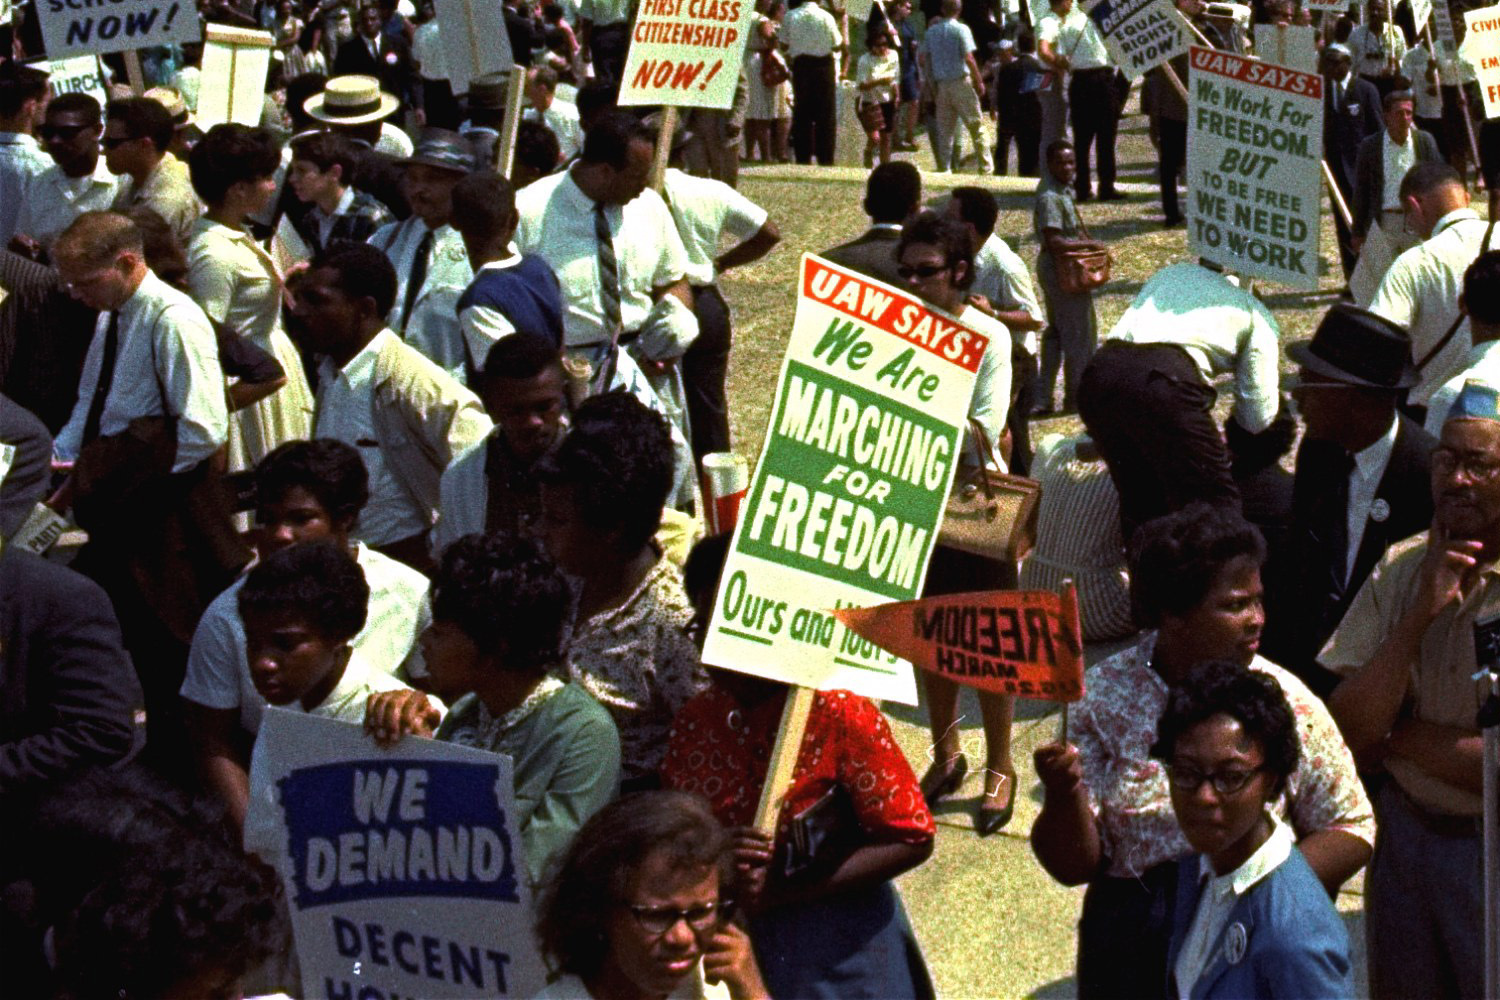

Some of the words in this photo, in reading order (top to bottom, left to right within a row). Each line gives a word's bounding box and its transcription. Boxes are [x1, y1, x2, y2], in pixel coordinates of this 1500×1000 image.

[66, 2, 179, 46] NOW!
[634, 21, 738, 48] CITIZENSHIP
[1114, 10, 1168, 41] EQUAL
[1120, 20, 1177, 53] RIGHTS
[1131, 30, 1183, 69] NOW!
[1194, 51, 1243, 76] UAW
[1247, 64, 1319, 95] SAYS:
[631, 60, 723, 91] NOW!
[1197, 78, 1220, 106] We
[1224, 86, 1272, 120] Work
[1278, 100, 1314, 128] For
[1219, 148, 1279, 180] BUT
[1196, 189, 1228, 222] WE
[1234, 202, 1309, 244] NEED
[1202, 170, 1222, 190] TO
[1227, 178, 1249, 200] BE
[1255, 186, 1301, 213] FREE
[1194, 215, 1222, 248] TO
[1227, 230, 1308, 274] WORK
[810, 267, 894, 322] UAW
[893, 304, 983, 364] SAYS:
[812, 316, 874, 371] We
[875, 348, 941, 402] Are
[778, 375, 950, 491] MARCHING
[822, 464, 891, 504] FOR
[749, 474, 928, 590] FREEDOM
[722, 570, 787, 634] Ours
[789, 599, 841, 648] and
[353, 767, 429, 825] WE
[305, 823, 504, 893] DEMAND
[332, 915, 511, 994] DECENT
